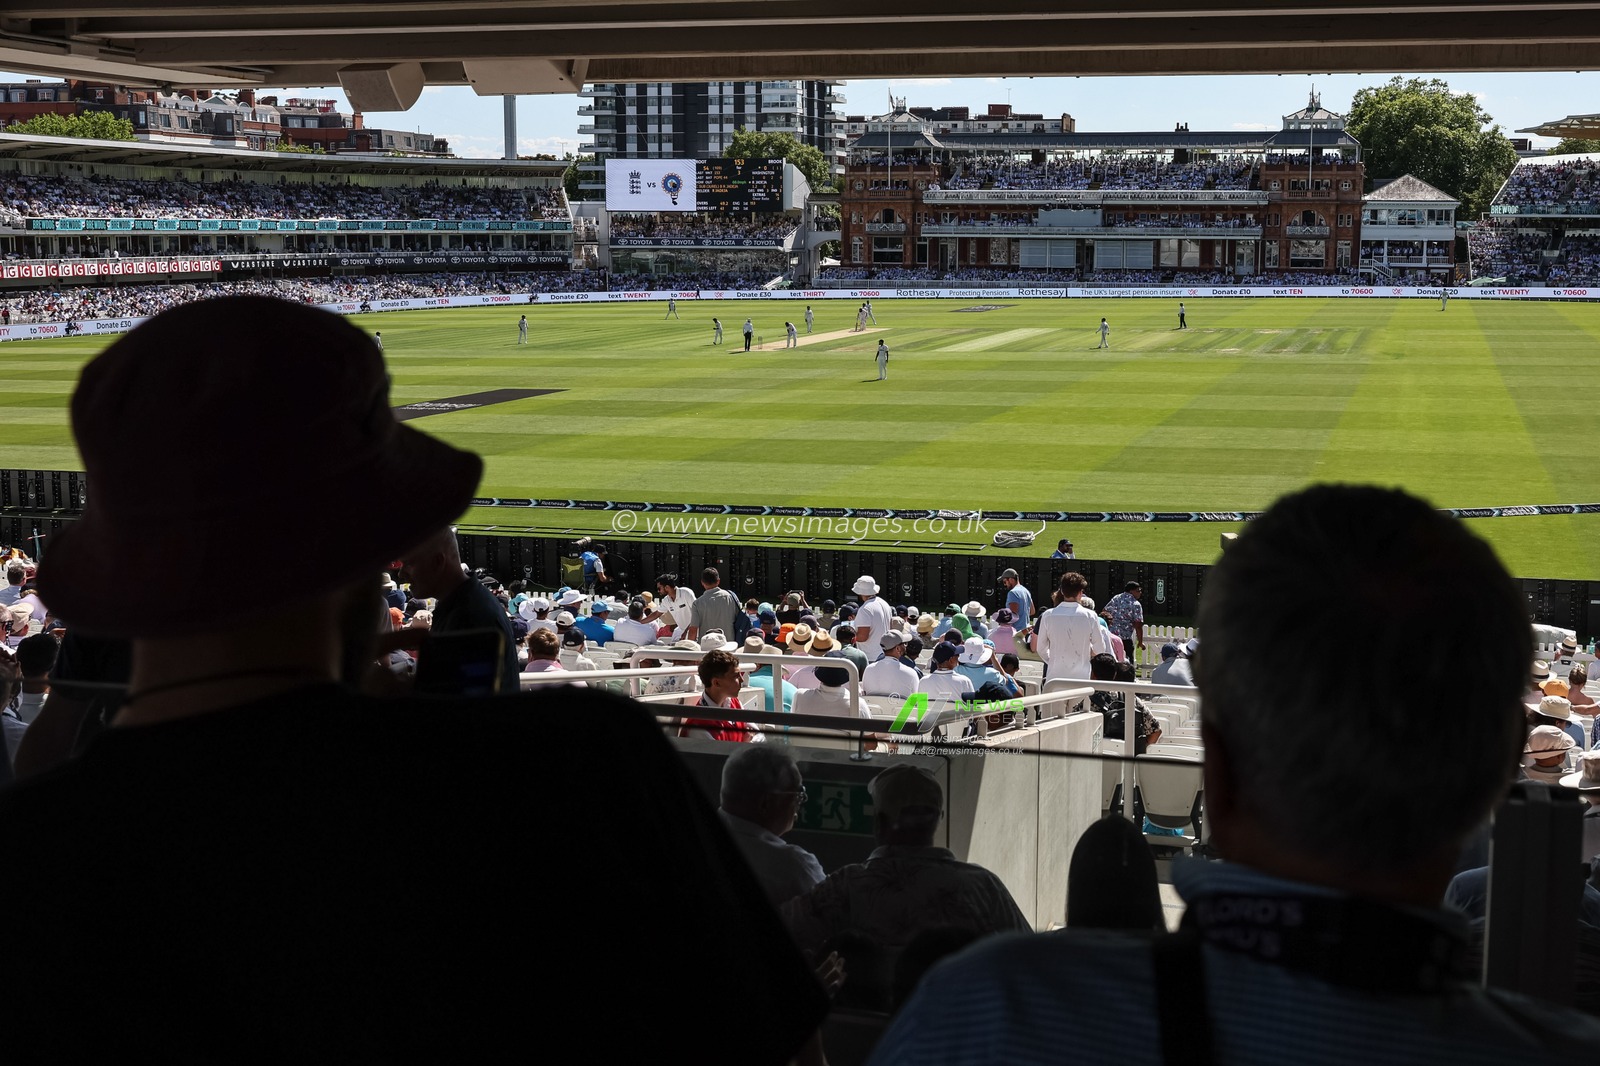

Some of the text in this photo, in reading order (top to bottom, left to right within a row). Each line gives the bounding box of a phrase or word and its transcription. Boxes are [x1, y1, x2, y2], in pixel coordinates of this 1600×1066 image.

[33, 220, 54, 229] BREWDOG
[462, 222, 484, 230] BREWDOG
[517, 222, 538, 230] BREWDOG
[241, 260, 275, 268] CASTORE
[6, 261, 219, 277] IG IG IG IG IG IG IG IG IG IG IG IG IG IG IG IG IG IG
[896, 289, 941, 298] Rothesay
[1018, 288, 1064, 297] Rothesay
[1109, 289, 1131, 297] largest
[1132, 289, 1157, 297] pension
[38, 326, 58, 334] 70600
[97, 322, 119, 330] Donate
